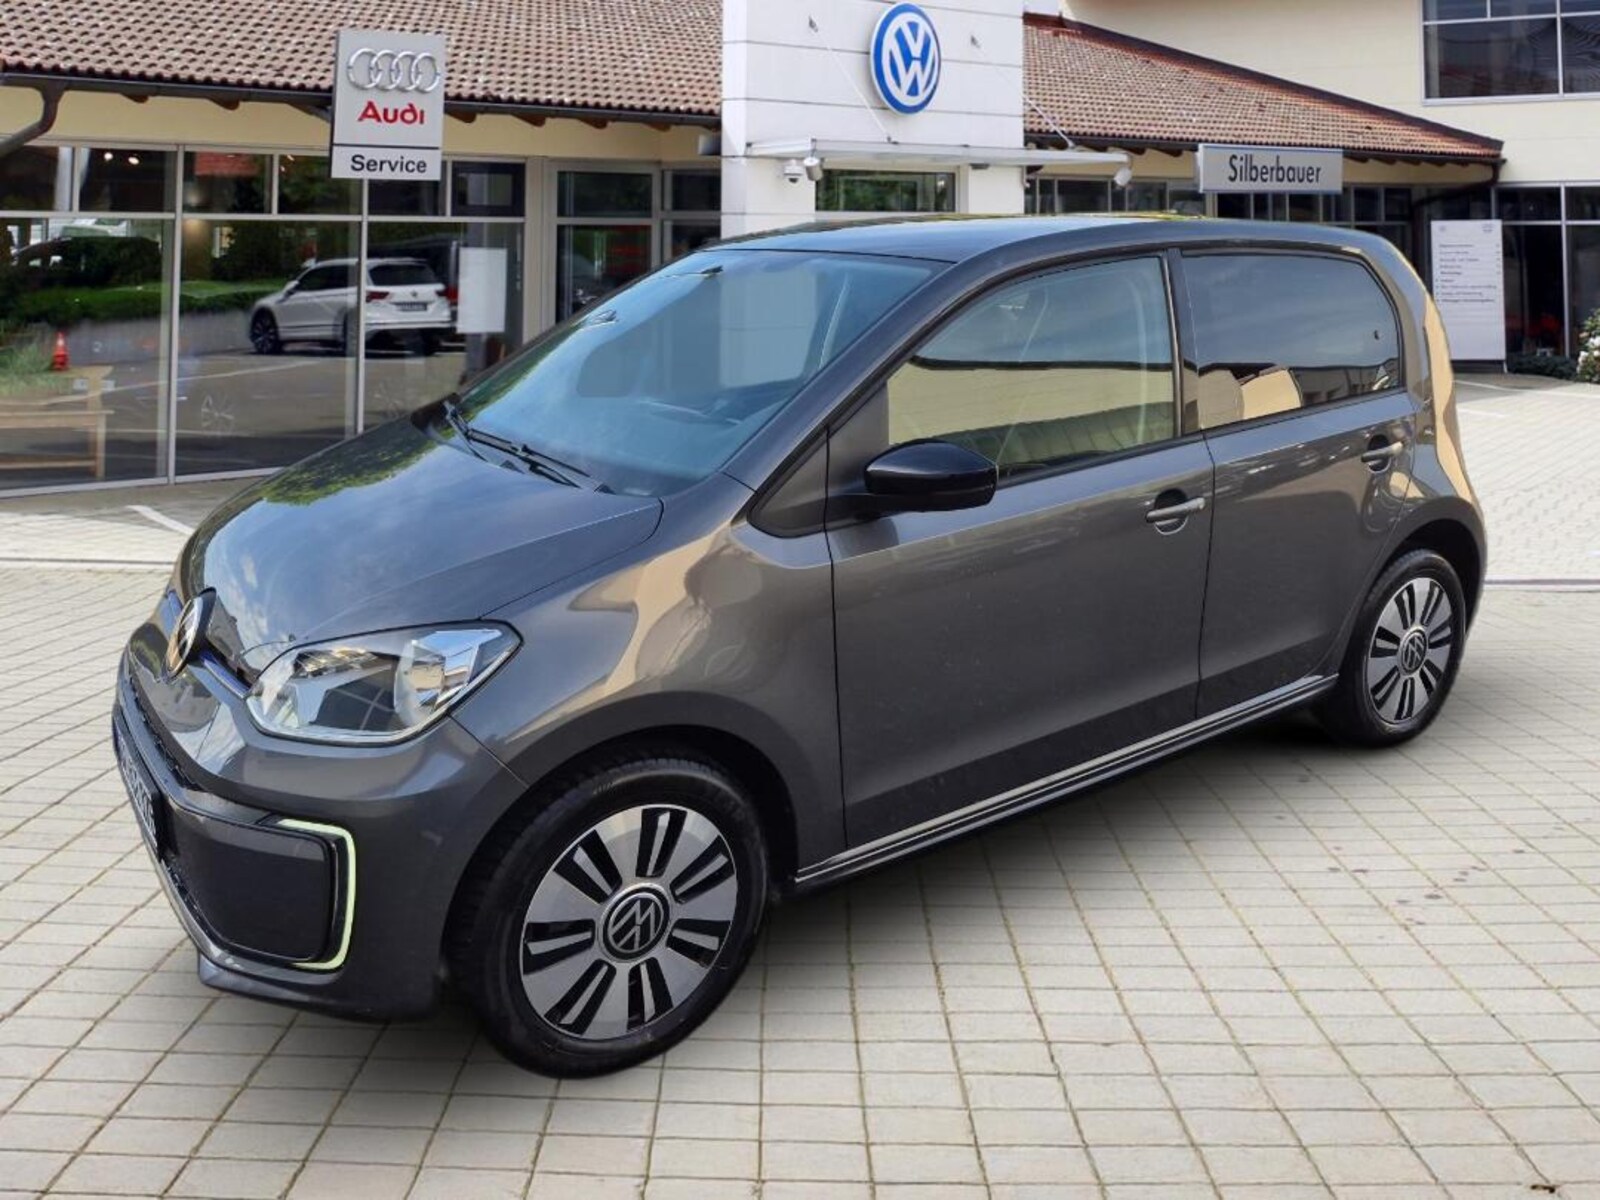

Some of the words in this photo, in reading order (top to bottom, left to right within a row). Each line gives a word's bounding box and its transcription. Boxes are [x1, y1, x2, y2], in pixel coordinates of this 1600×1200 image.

[358, 100, 425, 125] Audi
[350, 154, 427, 173] Service
[1228, 154, 1321, 183] Silberbauer
